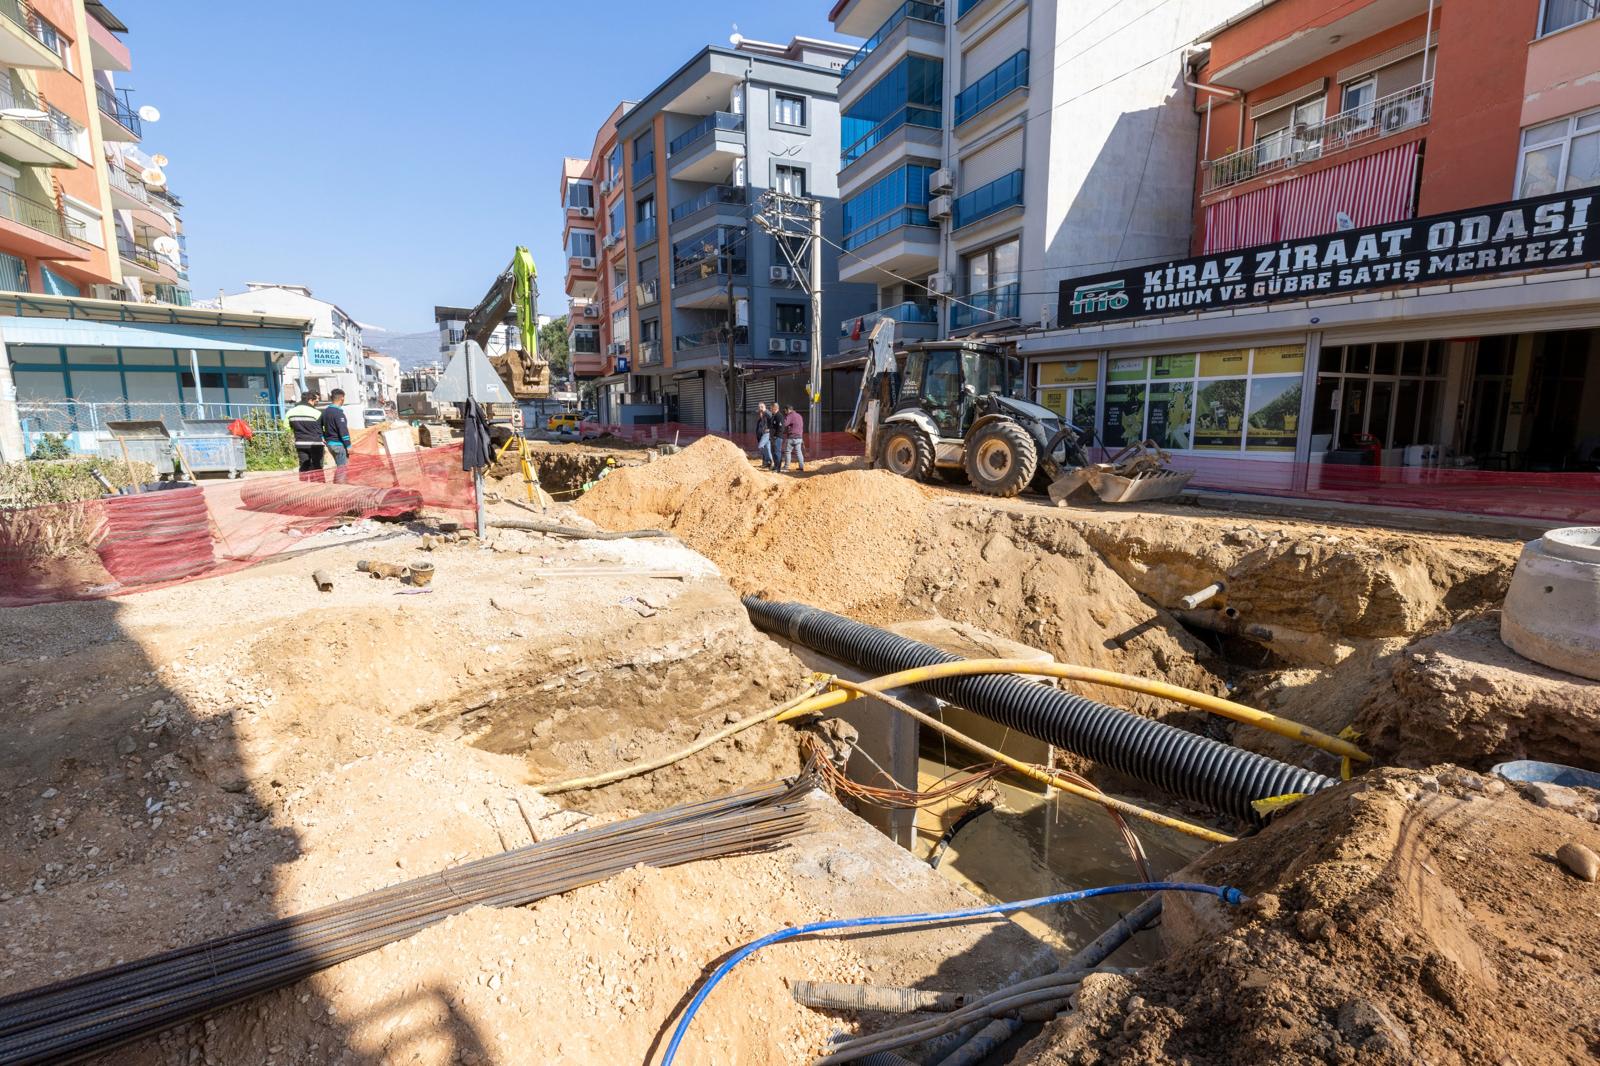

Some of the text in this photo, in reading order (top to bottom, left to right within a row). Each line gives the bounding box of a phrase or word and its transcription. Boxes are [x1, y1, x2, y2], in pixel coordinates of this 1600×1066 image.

[1143, 197, 1592, 294] KİRAZ ZİRAAT ODASI
[1143, 232, 1585, 311] TOHUM VE GÜBRE SATIŞ MERKEZİ
